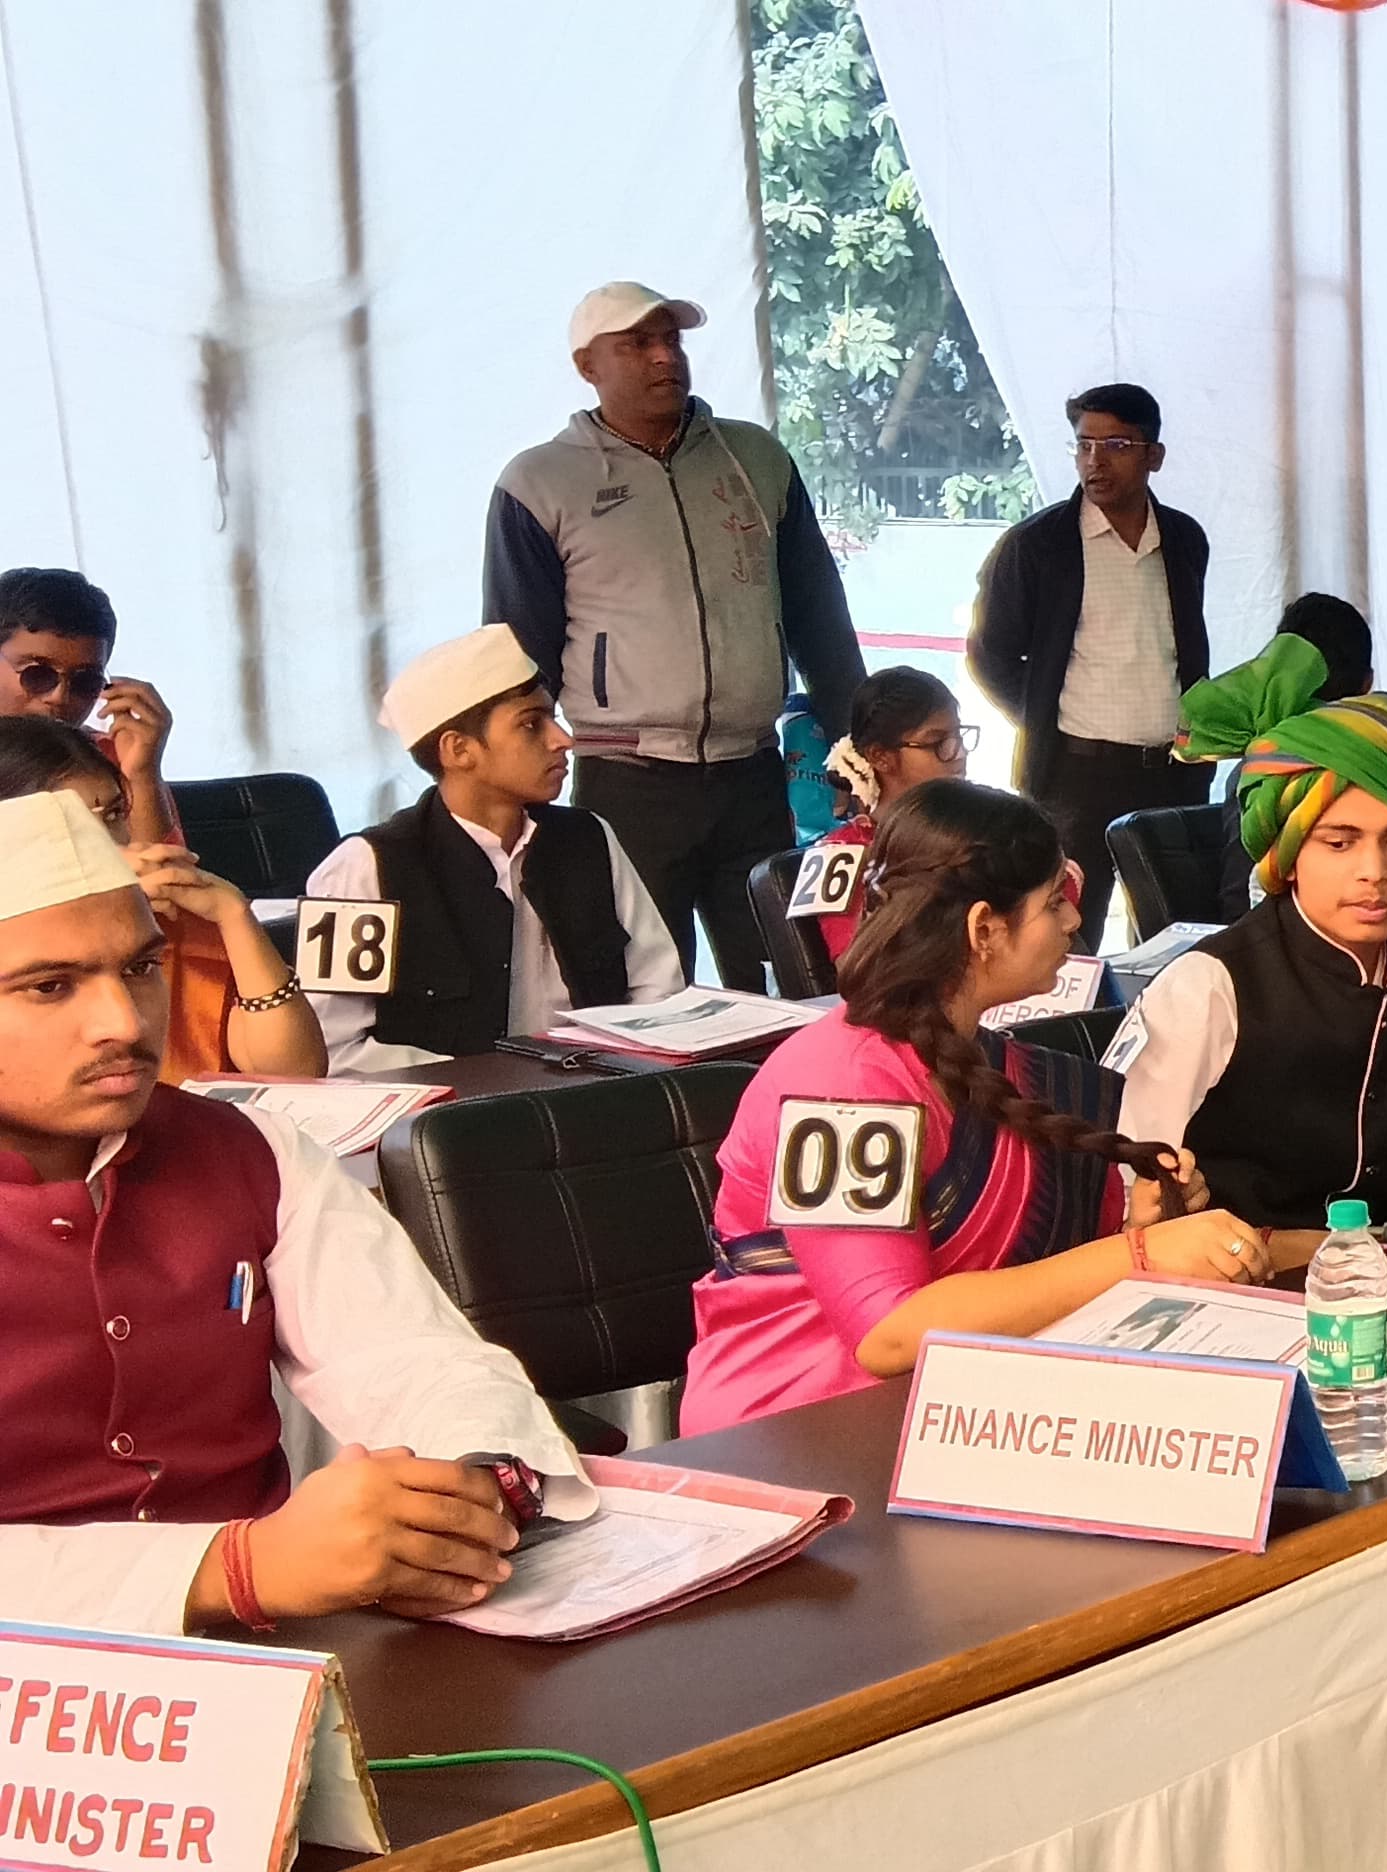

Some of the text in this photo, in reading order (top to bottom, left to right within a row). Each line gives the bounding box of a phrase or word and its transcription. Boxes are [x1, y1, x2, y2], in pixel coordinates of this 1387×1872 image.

[793, 853, 854, 907] 26
[306, 910, 386, 983] 18
[783, 1118, 905, 1212] 09
[918, 1402, 1259, 1478] FINANCE MINISTER
[0, 1783, 215, 1864] INISTER
